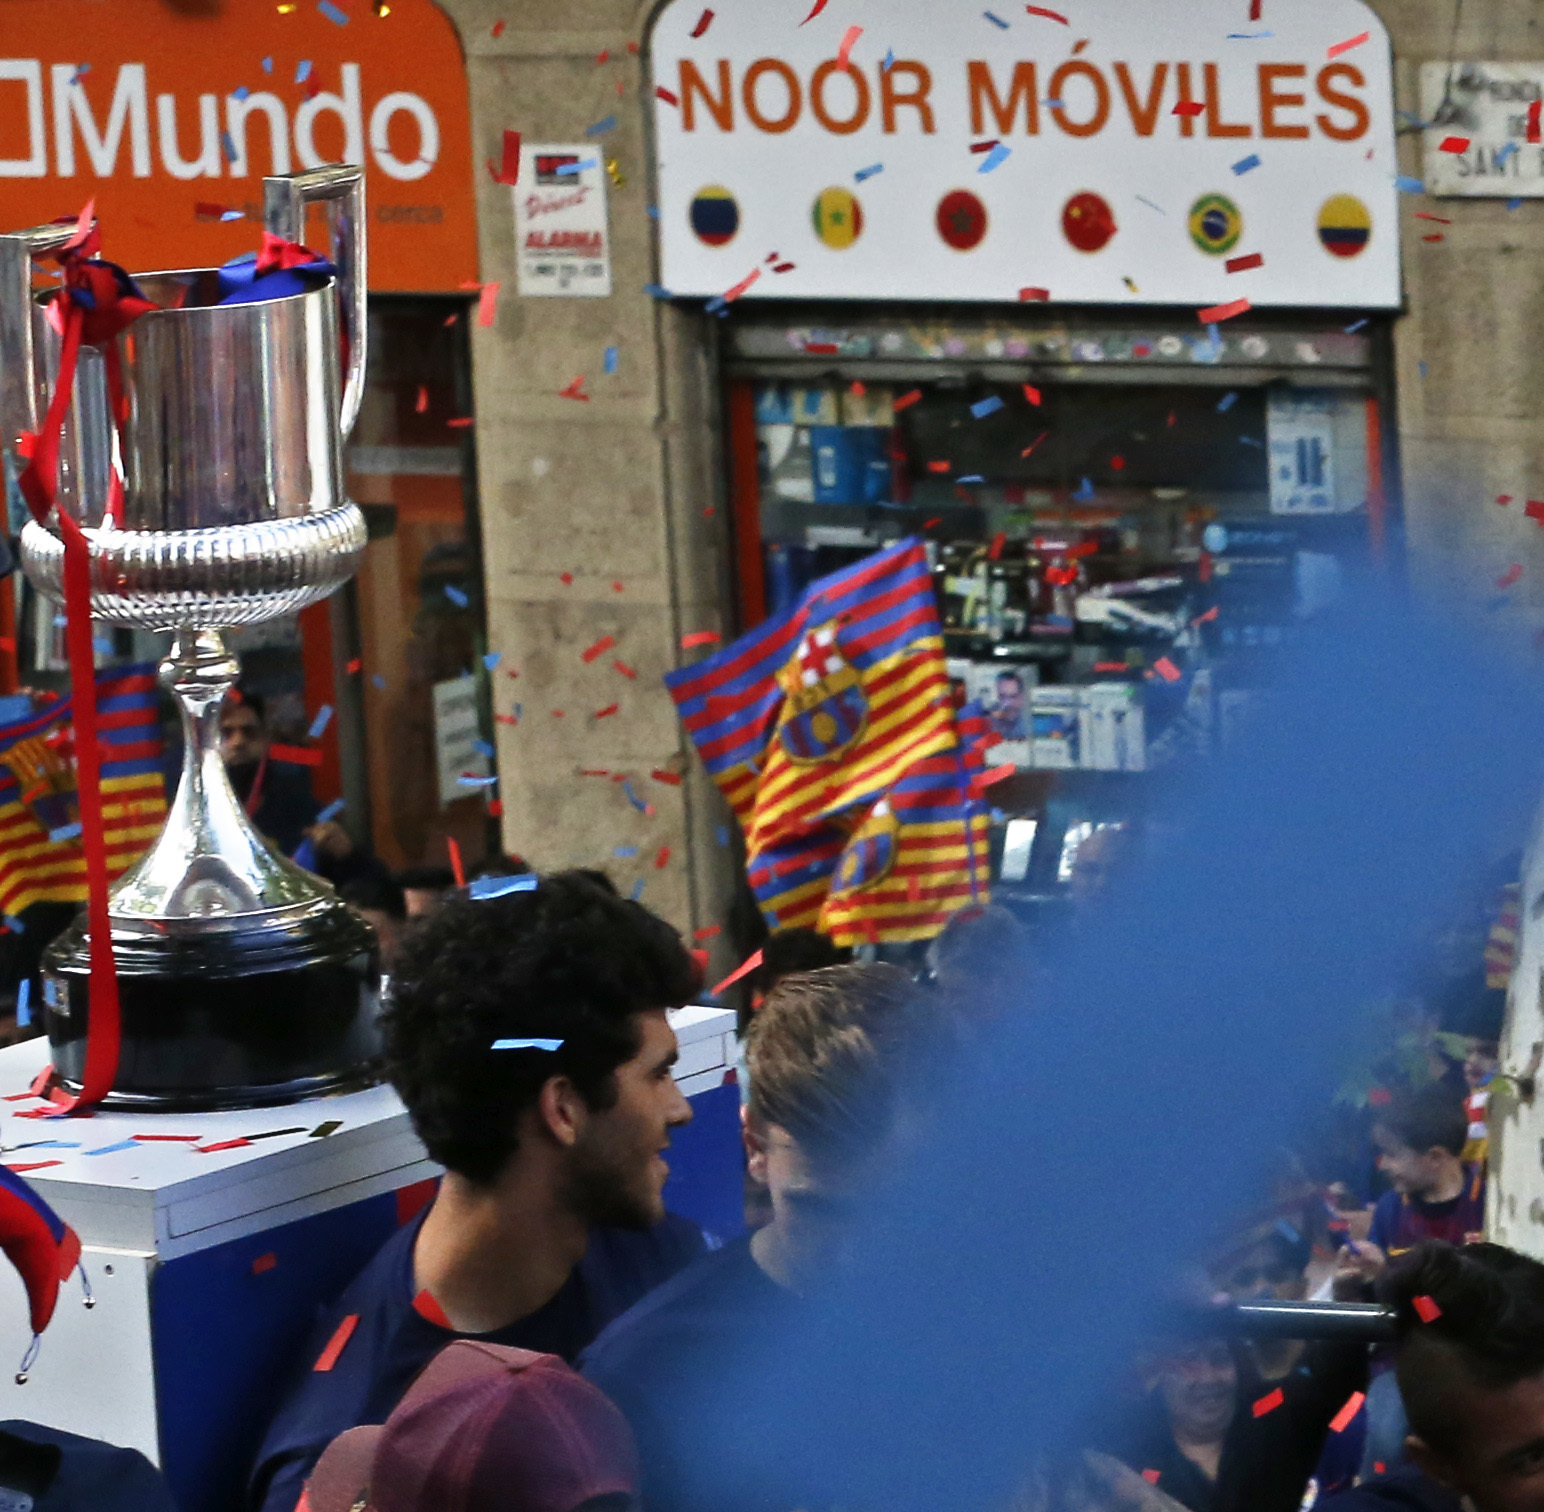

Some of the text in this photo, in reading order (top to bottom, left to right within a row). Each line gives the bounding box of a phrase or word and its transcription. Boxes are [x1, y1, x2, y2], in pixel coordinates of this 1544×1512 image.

[51, 62, 440, 180] Mundo
[678, 38, 1371, 141] NOOR MÓVILES
